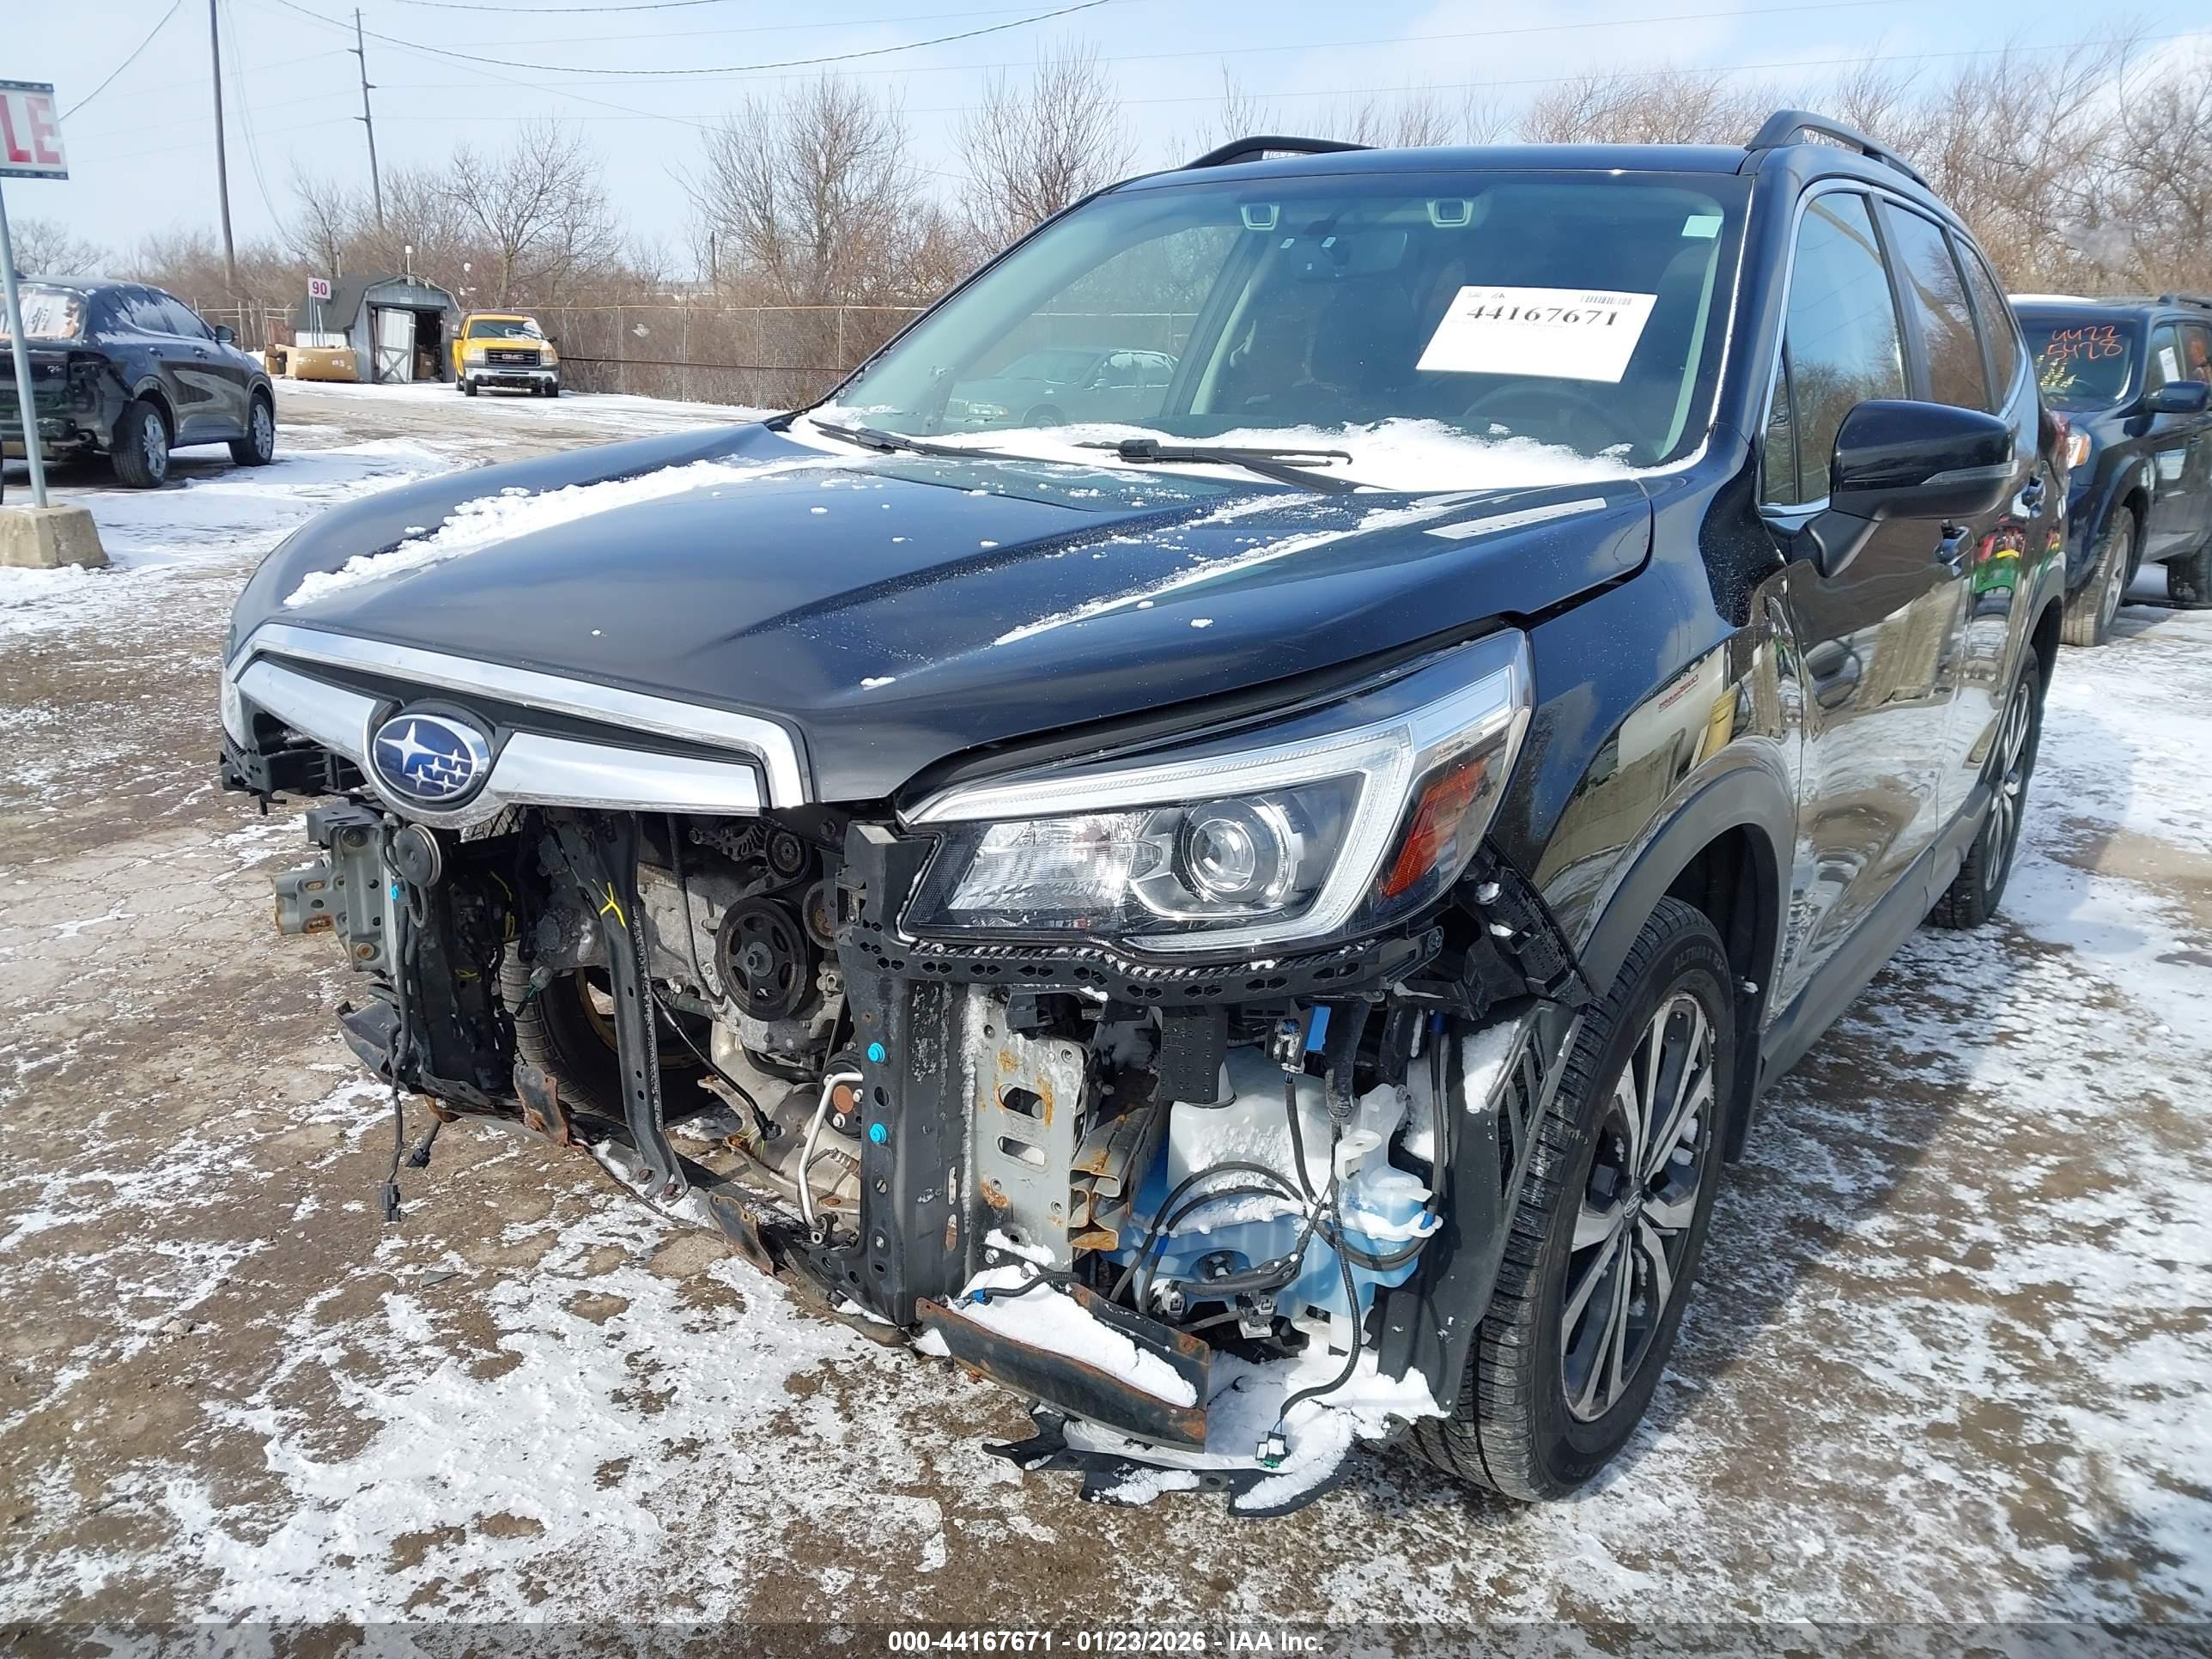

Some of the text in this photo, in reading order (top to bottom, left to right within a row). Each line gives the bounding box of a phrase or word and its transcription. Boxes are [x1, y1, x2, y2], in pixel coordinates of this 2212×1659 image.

[313, 281, 327, 295] 90
[1467, 305, 1619, 326] 44167671
[2047, 338, 2123, 359] 5428
